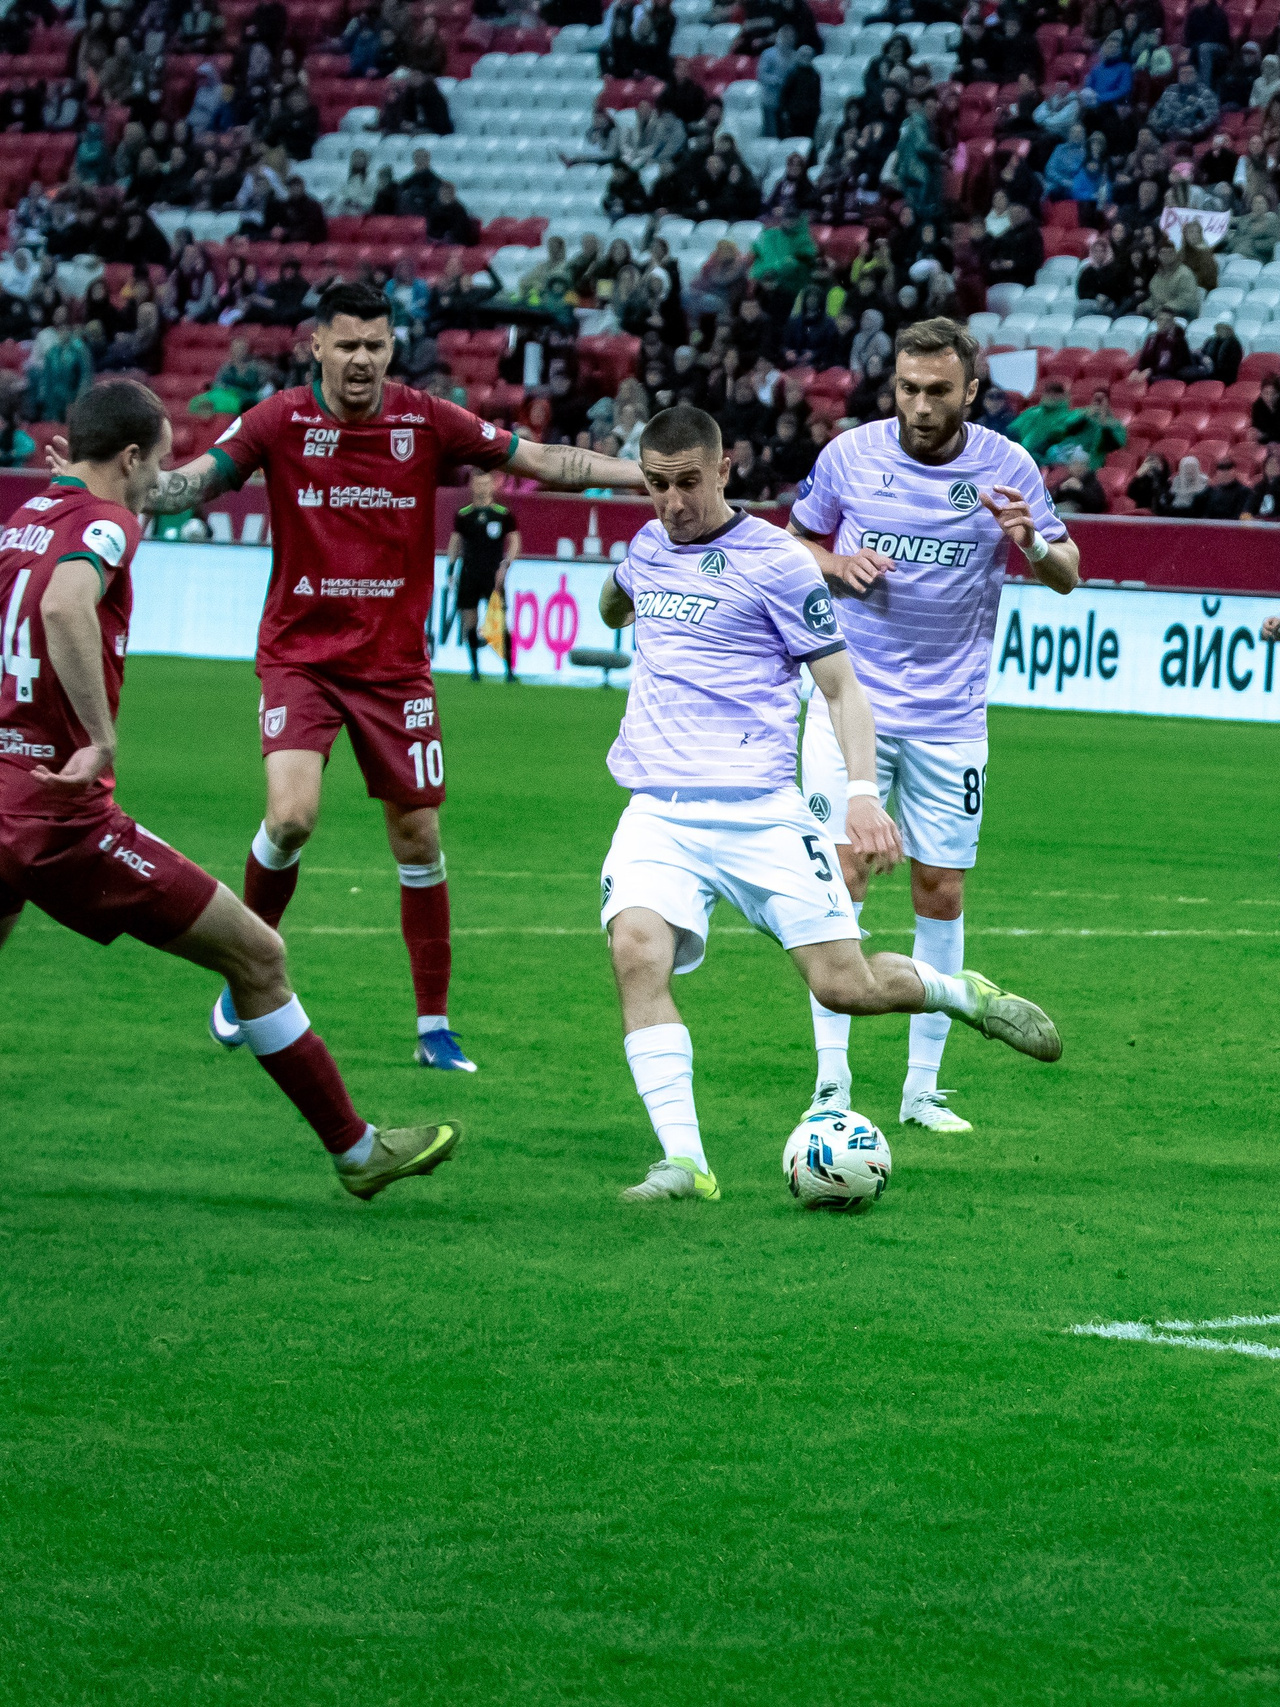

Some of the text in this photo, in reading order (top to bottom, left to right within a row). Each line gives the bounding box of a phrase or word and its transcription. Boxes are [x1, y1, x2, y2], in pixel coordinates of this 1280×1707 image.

[304, 428, 340, 442] FON
[303, 442, 338, 457] BET
[330, 486, 392, 498] КАЗАНЬ
[330, 496, 416, 508] ОРГСИНТЕЗ
[1000, 608, 1119, 692] Apple
[404, 697, 433, 714] FON
[405, 712, 435, 729] BET
[407, 739, 444, 789] 10
[802, 834, 833, 883] 5
